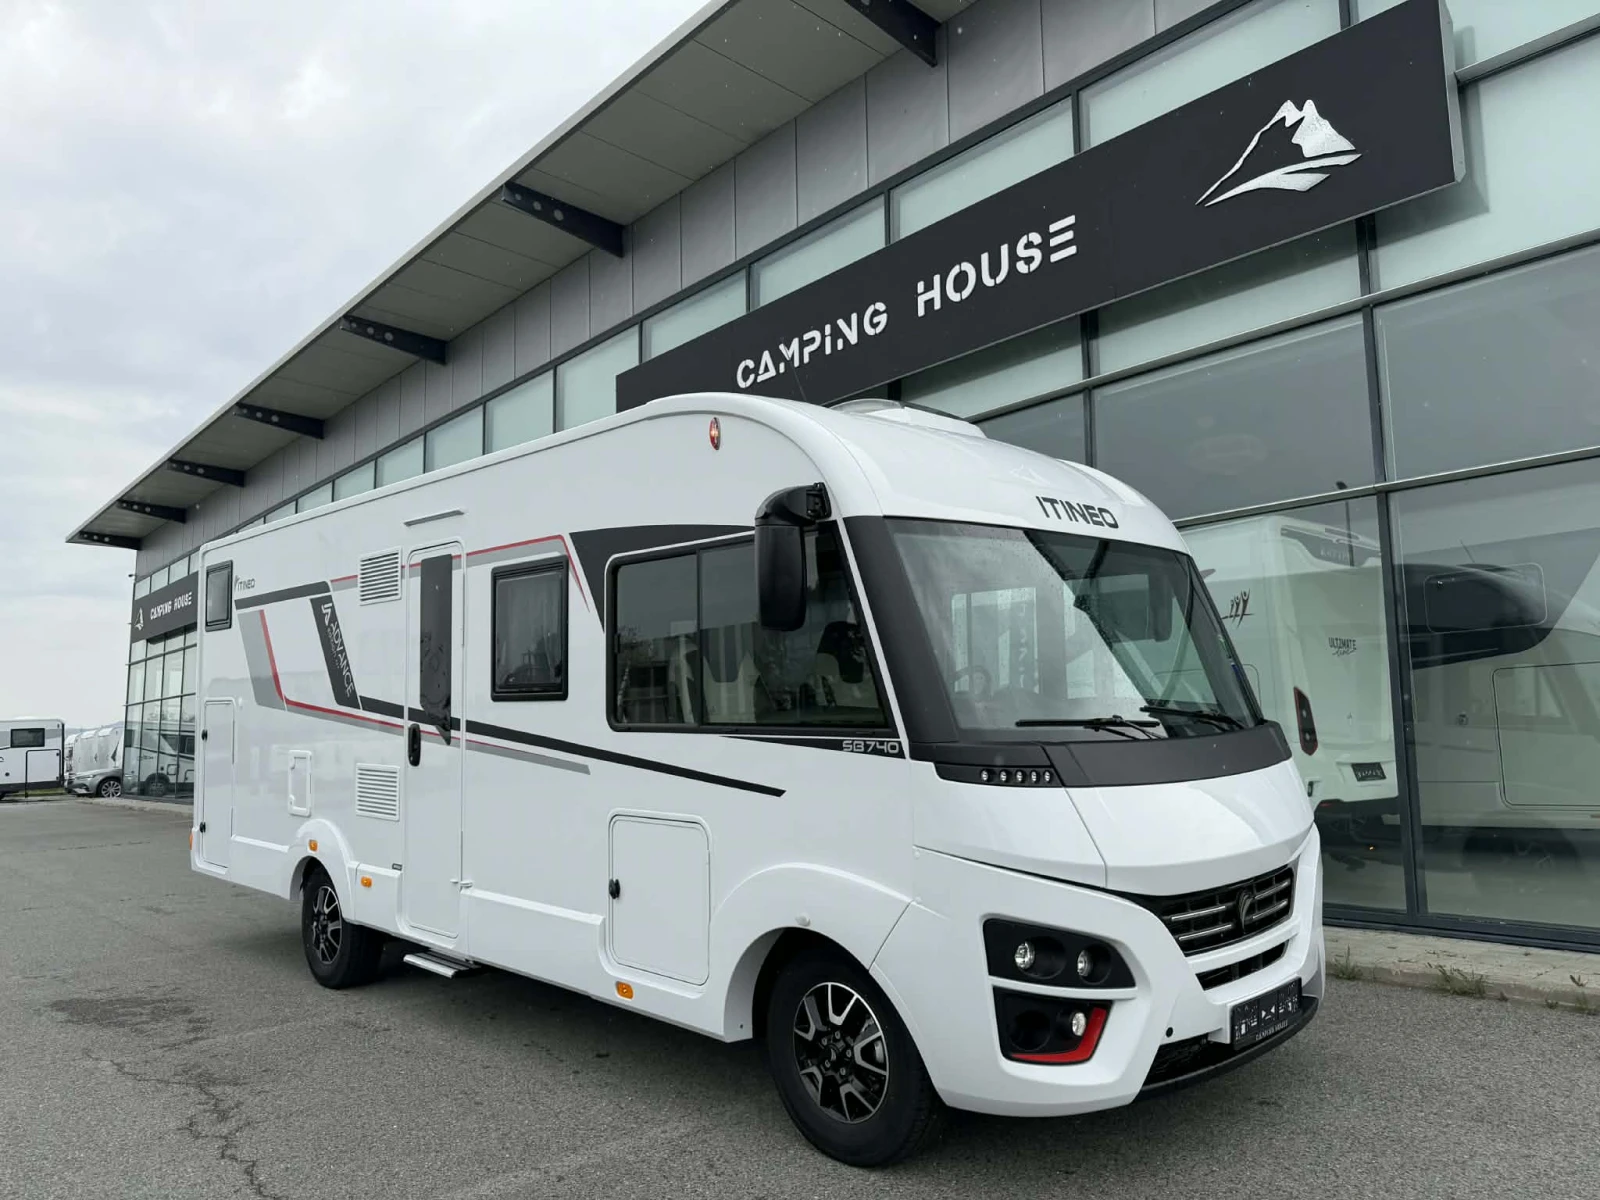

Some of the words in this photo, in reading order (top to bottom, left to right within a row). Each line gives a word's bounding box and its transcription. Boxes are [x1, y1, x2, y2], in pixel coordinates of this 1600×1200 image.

[736, 302, 888, 389] CAMPING
[917, 215, 1077, 317] HOUSE
[1036, 495, 1119, 529] ITINEO
[150, 600, 172, 620] CAMPING
[174, 591, 192, 611] HOUSE
[842, 740, 900, 754] SB740
